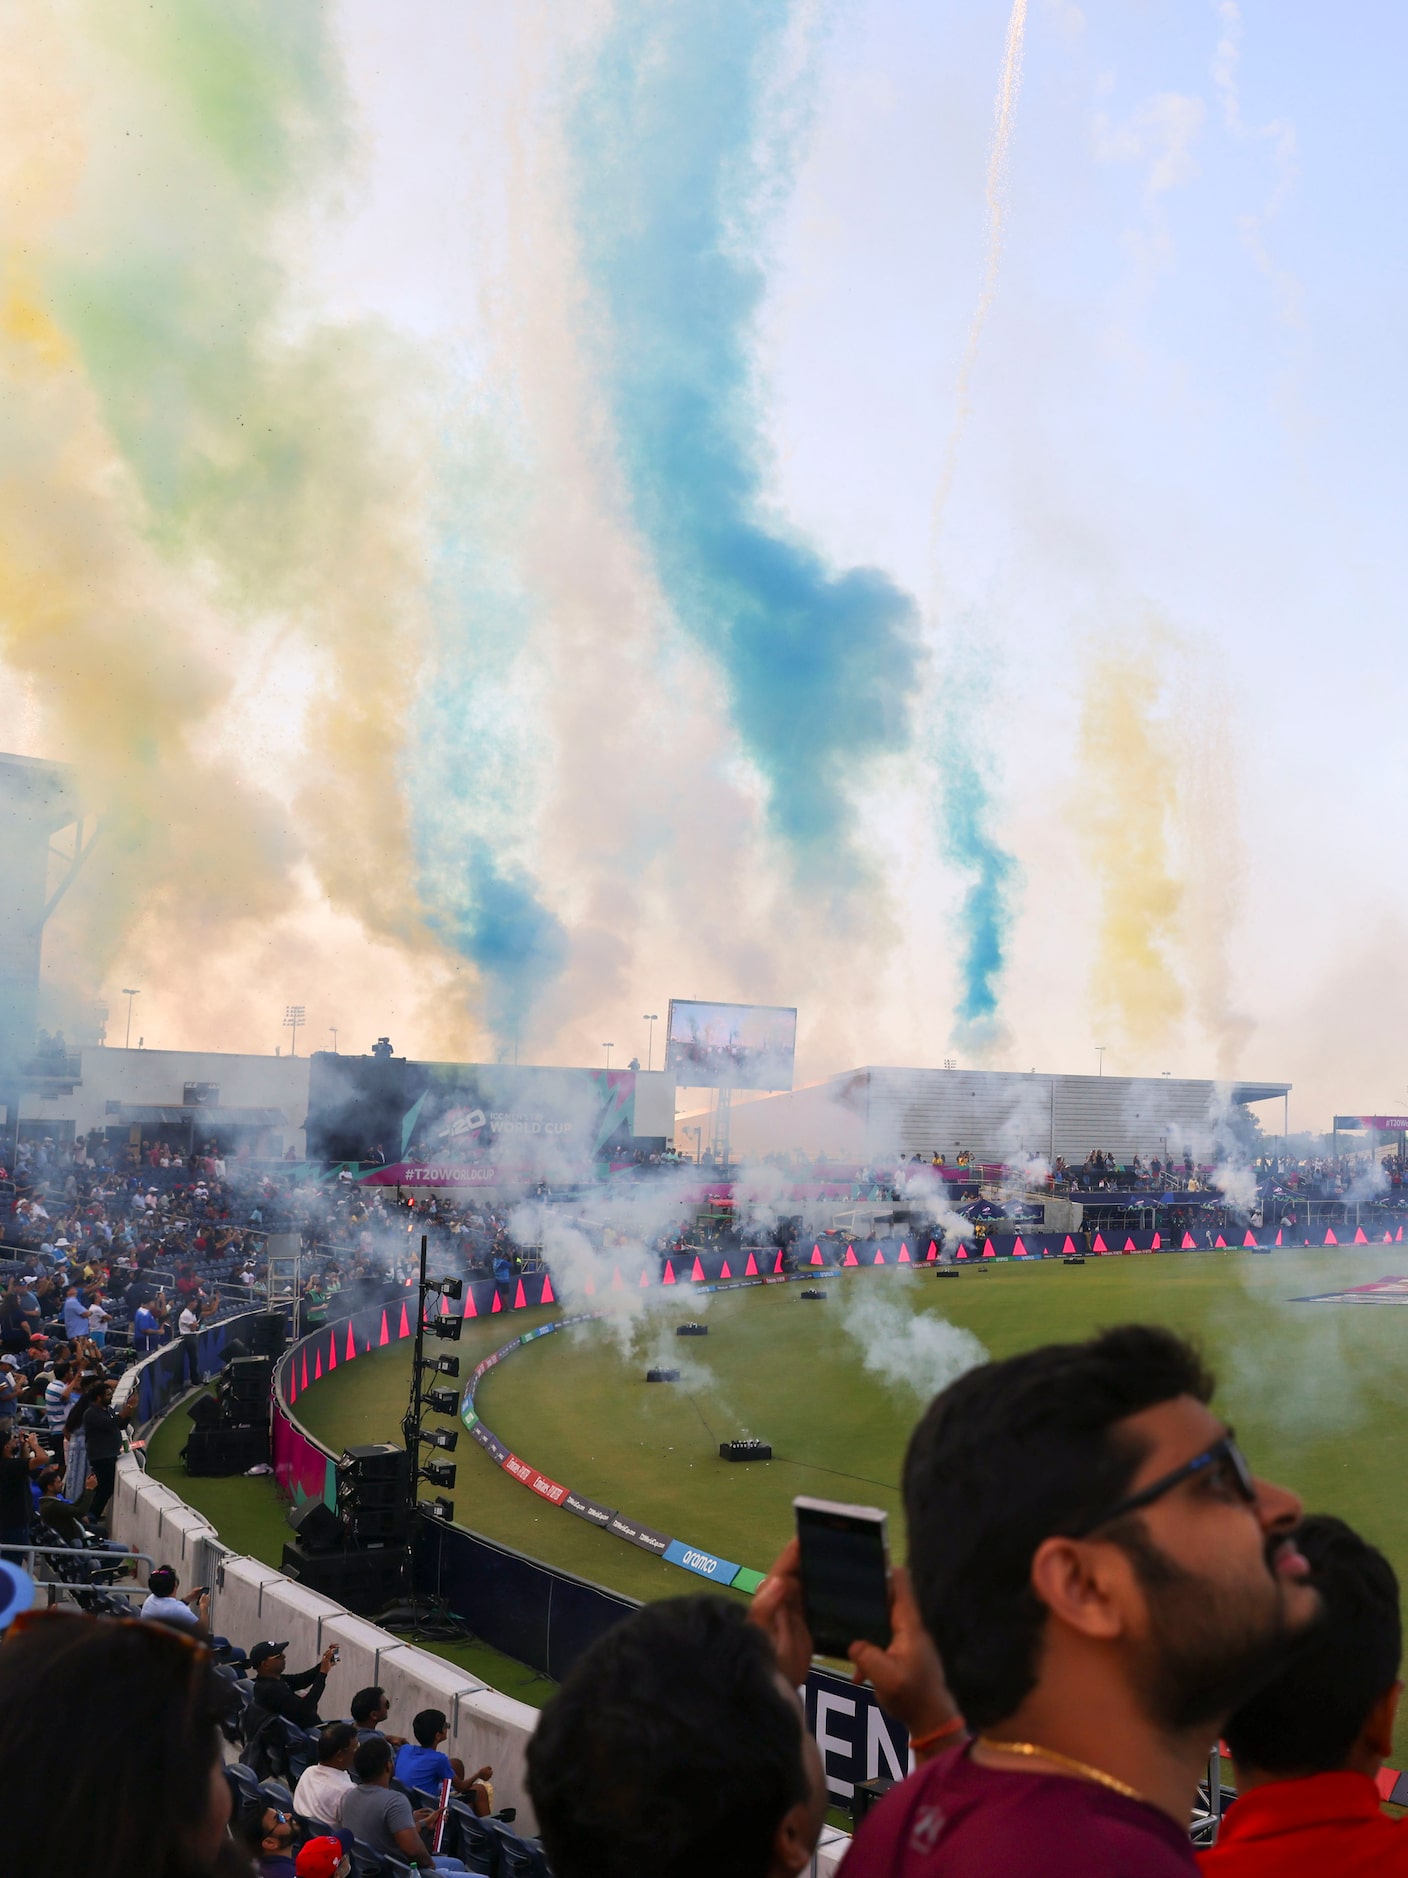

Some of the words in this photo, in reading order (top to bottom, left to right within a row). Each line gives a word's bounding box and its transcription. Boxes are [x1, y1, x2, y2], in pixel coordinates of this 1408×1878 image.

[490, 1121, 541, 1134] WORLD
[545, 1122, 573, 1135] CUP
[405, 1168, 495, 1181] #T20WORLDCUP
[682, 1549, 718, 1574] aramco
